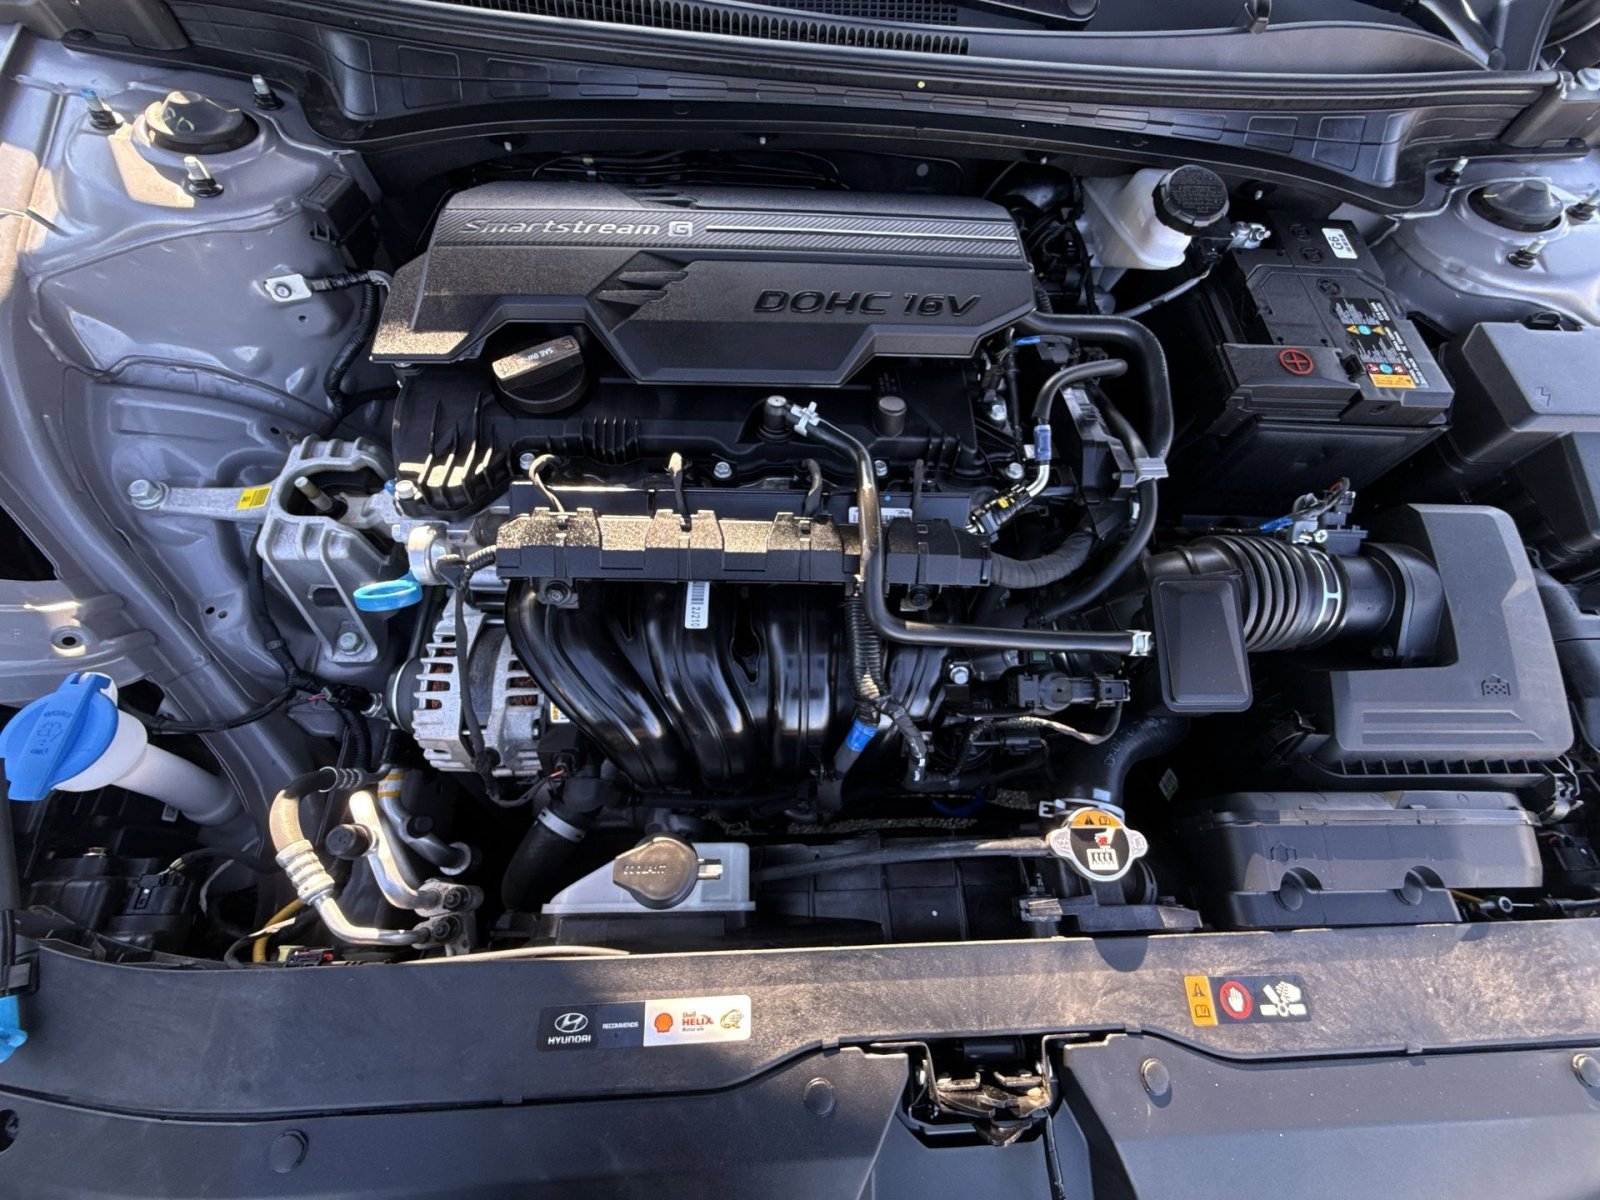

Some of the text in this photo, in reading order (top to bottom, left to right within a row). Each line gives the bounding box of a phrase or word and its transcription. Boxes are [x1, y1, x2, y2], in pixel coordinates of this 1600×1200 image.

[462, 217, 660, 239] Smartstream
[754, 289, 981, 316] DOHC 16V
[539, 347, 554, 358] SAE
[602, 1021, 639, 1030] RECOMMENDS
[682, 1015, 714, 1026] HELIX
[547, 1034, 592, 1045] HYUNDAI
